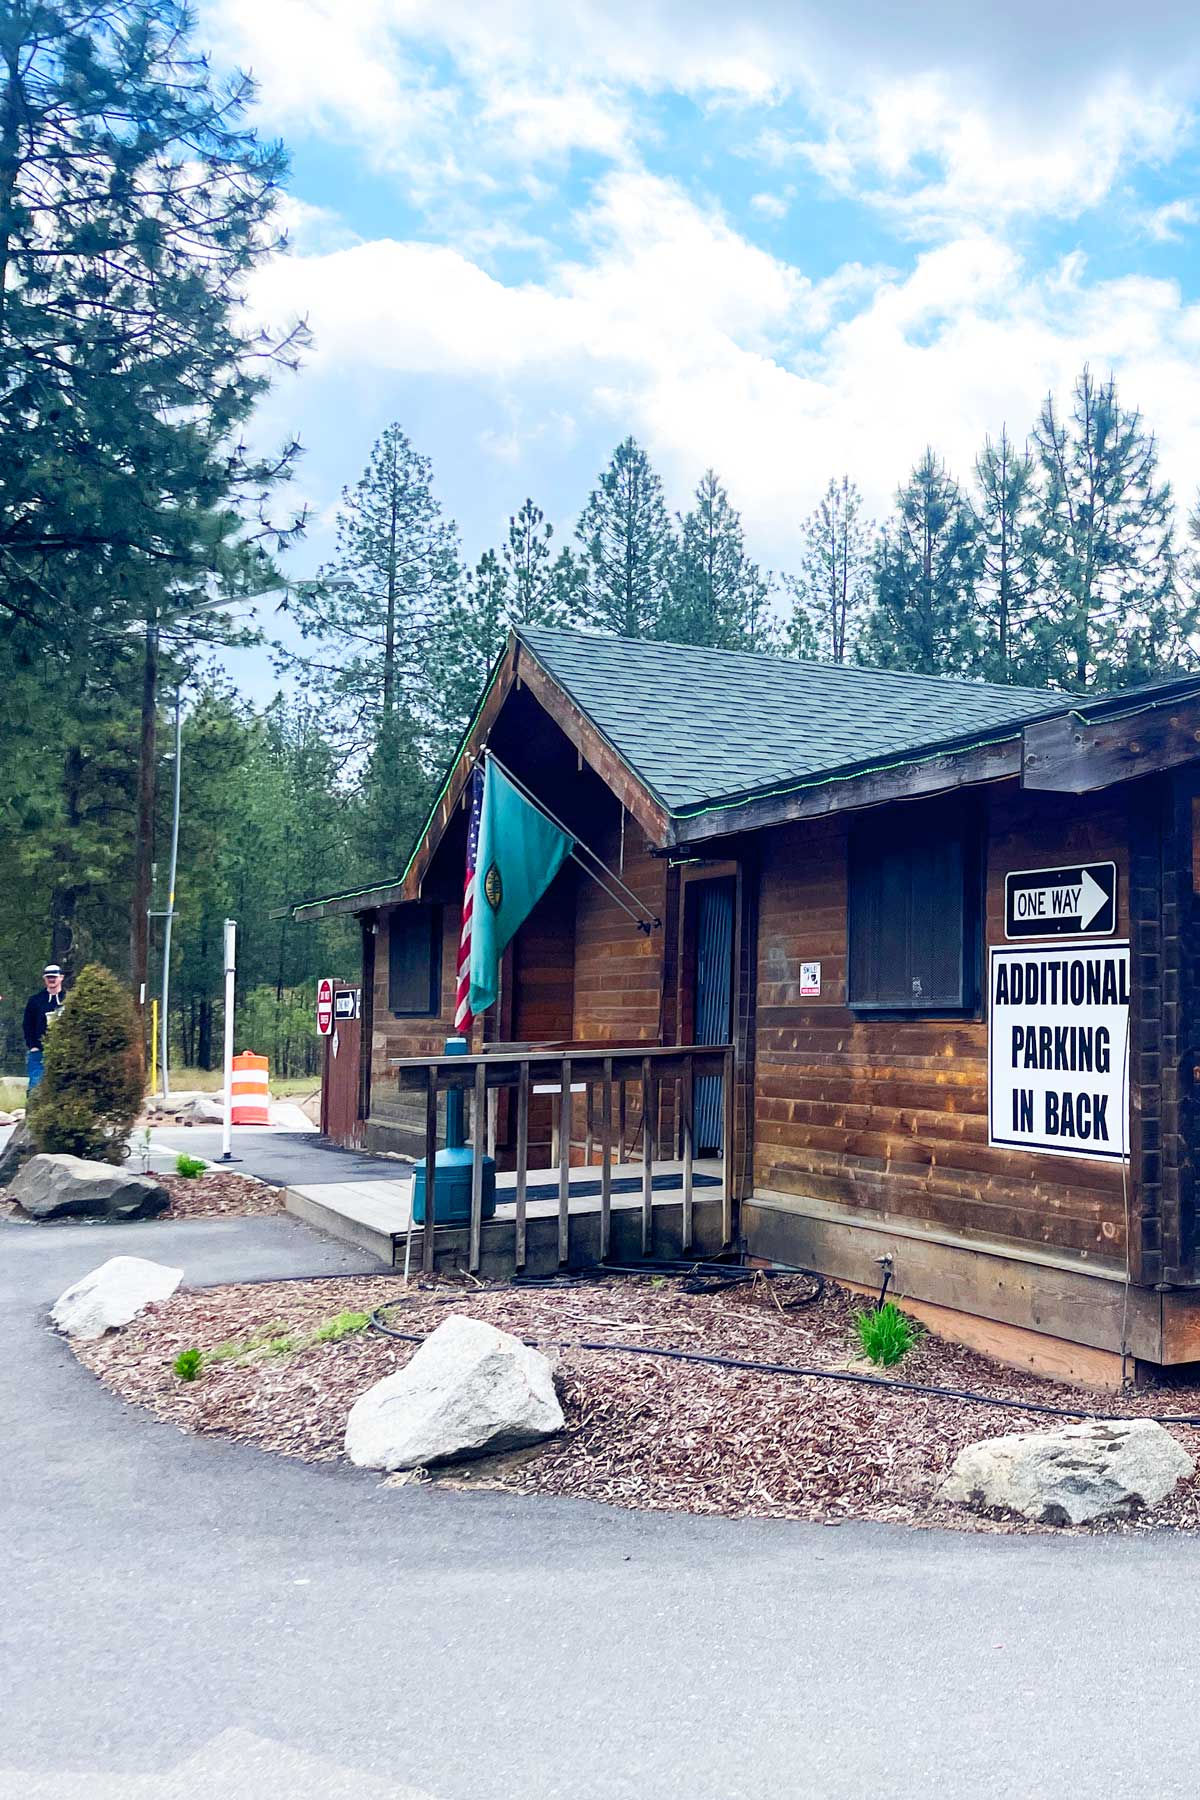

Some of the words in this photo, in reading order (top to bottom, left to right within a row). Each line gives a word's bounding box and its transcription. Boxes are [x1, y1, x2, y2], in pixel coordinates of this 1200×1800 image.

[1017, 890, 1046, 917] ONE
[1051, 887, 1082, 915] WAY
[995, 959, 1130, 1006] ADDITIONAL
[1011, 1025, 1111, 1074] PARKING
[1012, 1088, 1034, 1133] IN
[1045, 1090, 1109, 1142] BACK
